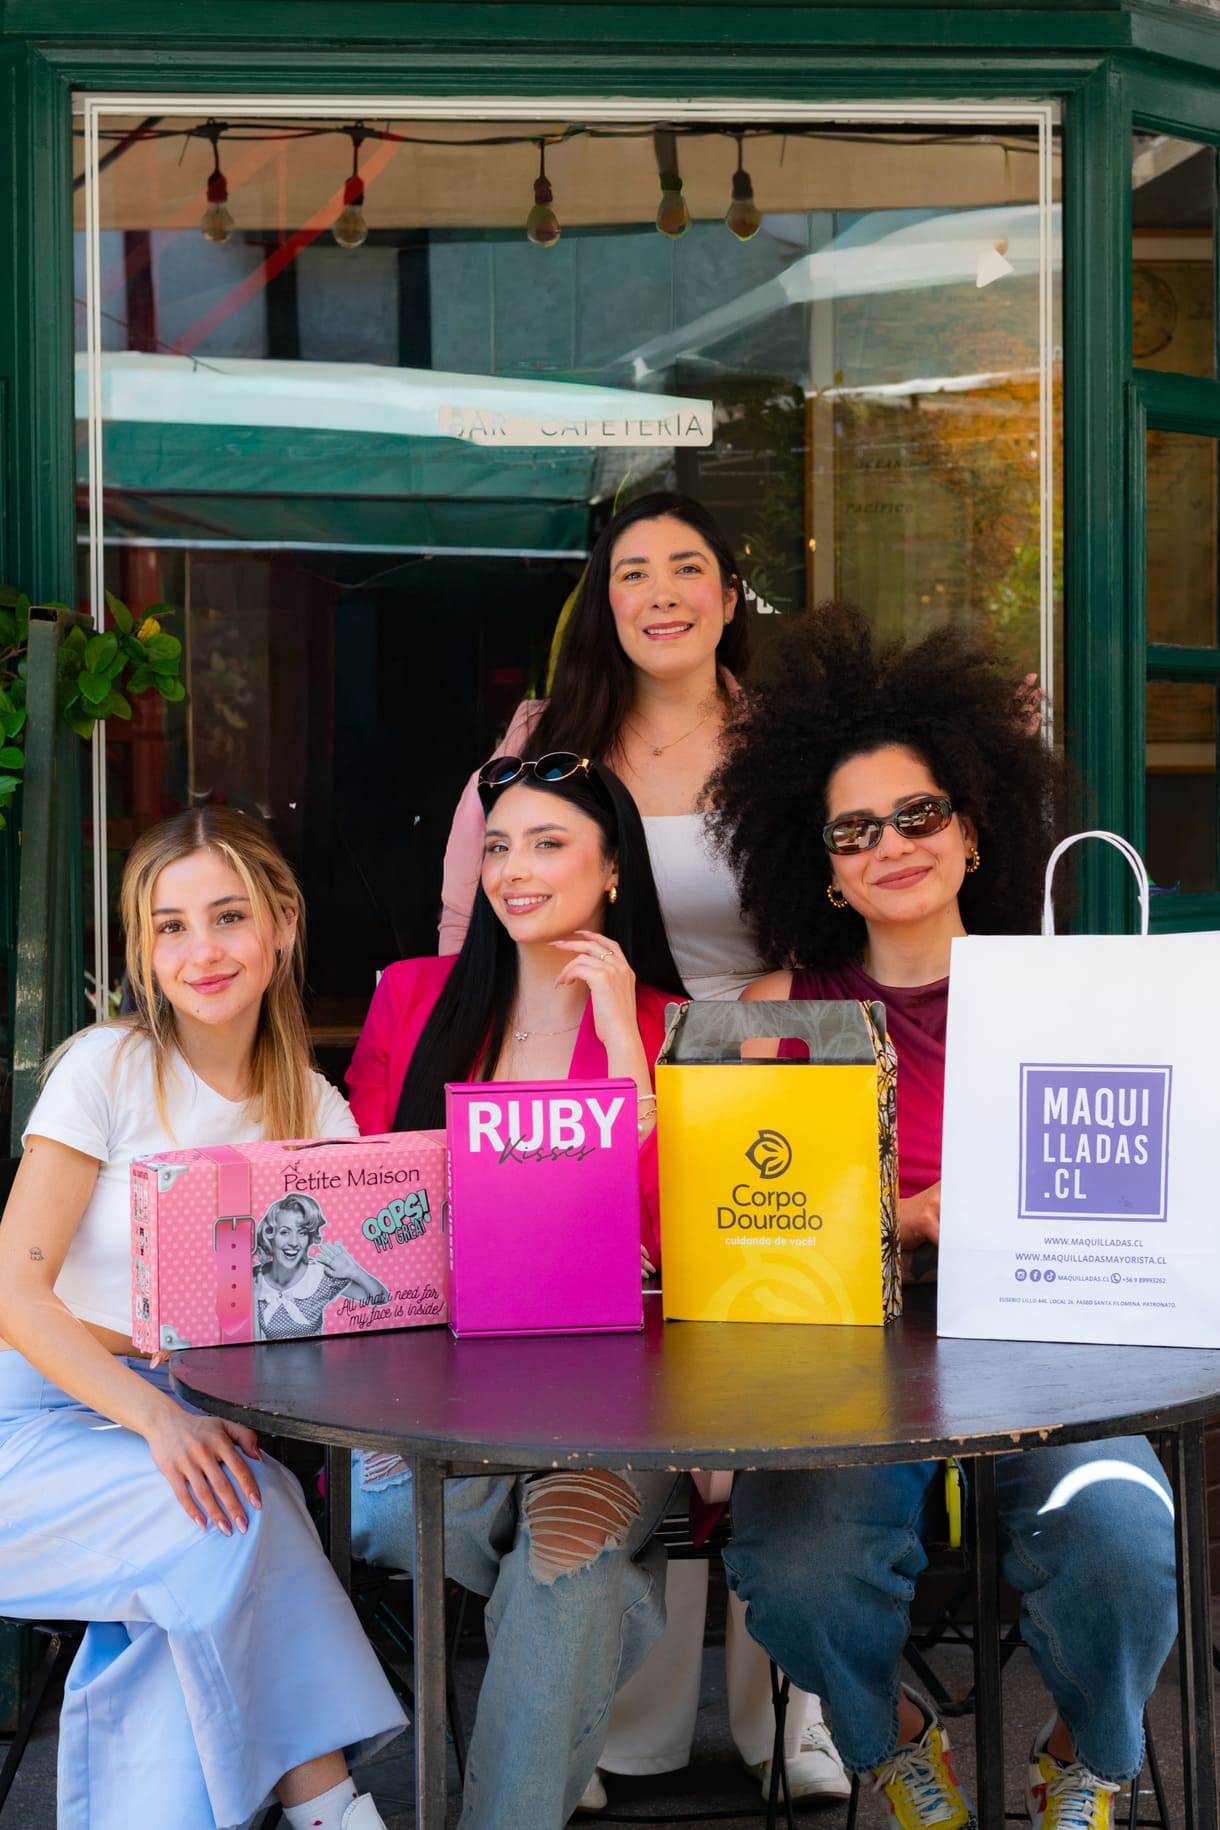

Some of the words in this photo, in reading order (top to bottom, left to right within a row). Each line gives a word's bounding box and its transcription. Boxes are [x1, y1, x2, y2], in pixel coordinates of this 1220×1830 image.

[1043, 1087, 1149, 1128] MAQUI
[468, 1097, 625, 1152] RUBY
[498, 1134, 596, 1164] Kisses
[1043, 1133, 1148, 1165] LLADAS
[284, 1170, 341, 1192] Petite
[347, 1165, 420, 1187] Maison
[1043, 1168, 1087, 1199] .CL
[732, 1184, 807, 1211] Corpo
[362, 1188, 432, 1240] OOPS!
[717, 1207, 823, 1231] Dourado
[373, 1232, 393, 1253] I'M
[395, 1219, 427, 1245] GREAT
[725, 1236, 771, 1246] cuidando
[774, 1236, 786, 1246] de
[1044, 1237, 1144, 1248] WWW.MAQUILLADAS.CL
[1015, 1252, 1167, 1265] WWW.MAQUILLADASMAYORISTA.CL
[1057, 1274, 1110, 1283] MAQUILLADAS.CL
[337, 1298, 356, 1316] All
[360, 1291, 386, 1308] what
[394, 1286, 419, 1300] need
[416, 1284, 440, 1304] for
[349, 1313, 369, 1328] my
[366, 1306, 392, 1327] face
[394, 1304, 404, 1317] is
[407, 1301, 445, 1317] inside!
